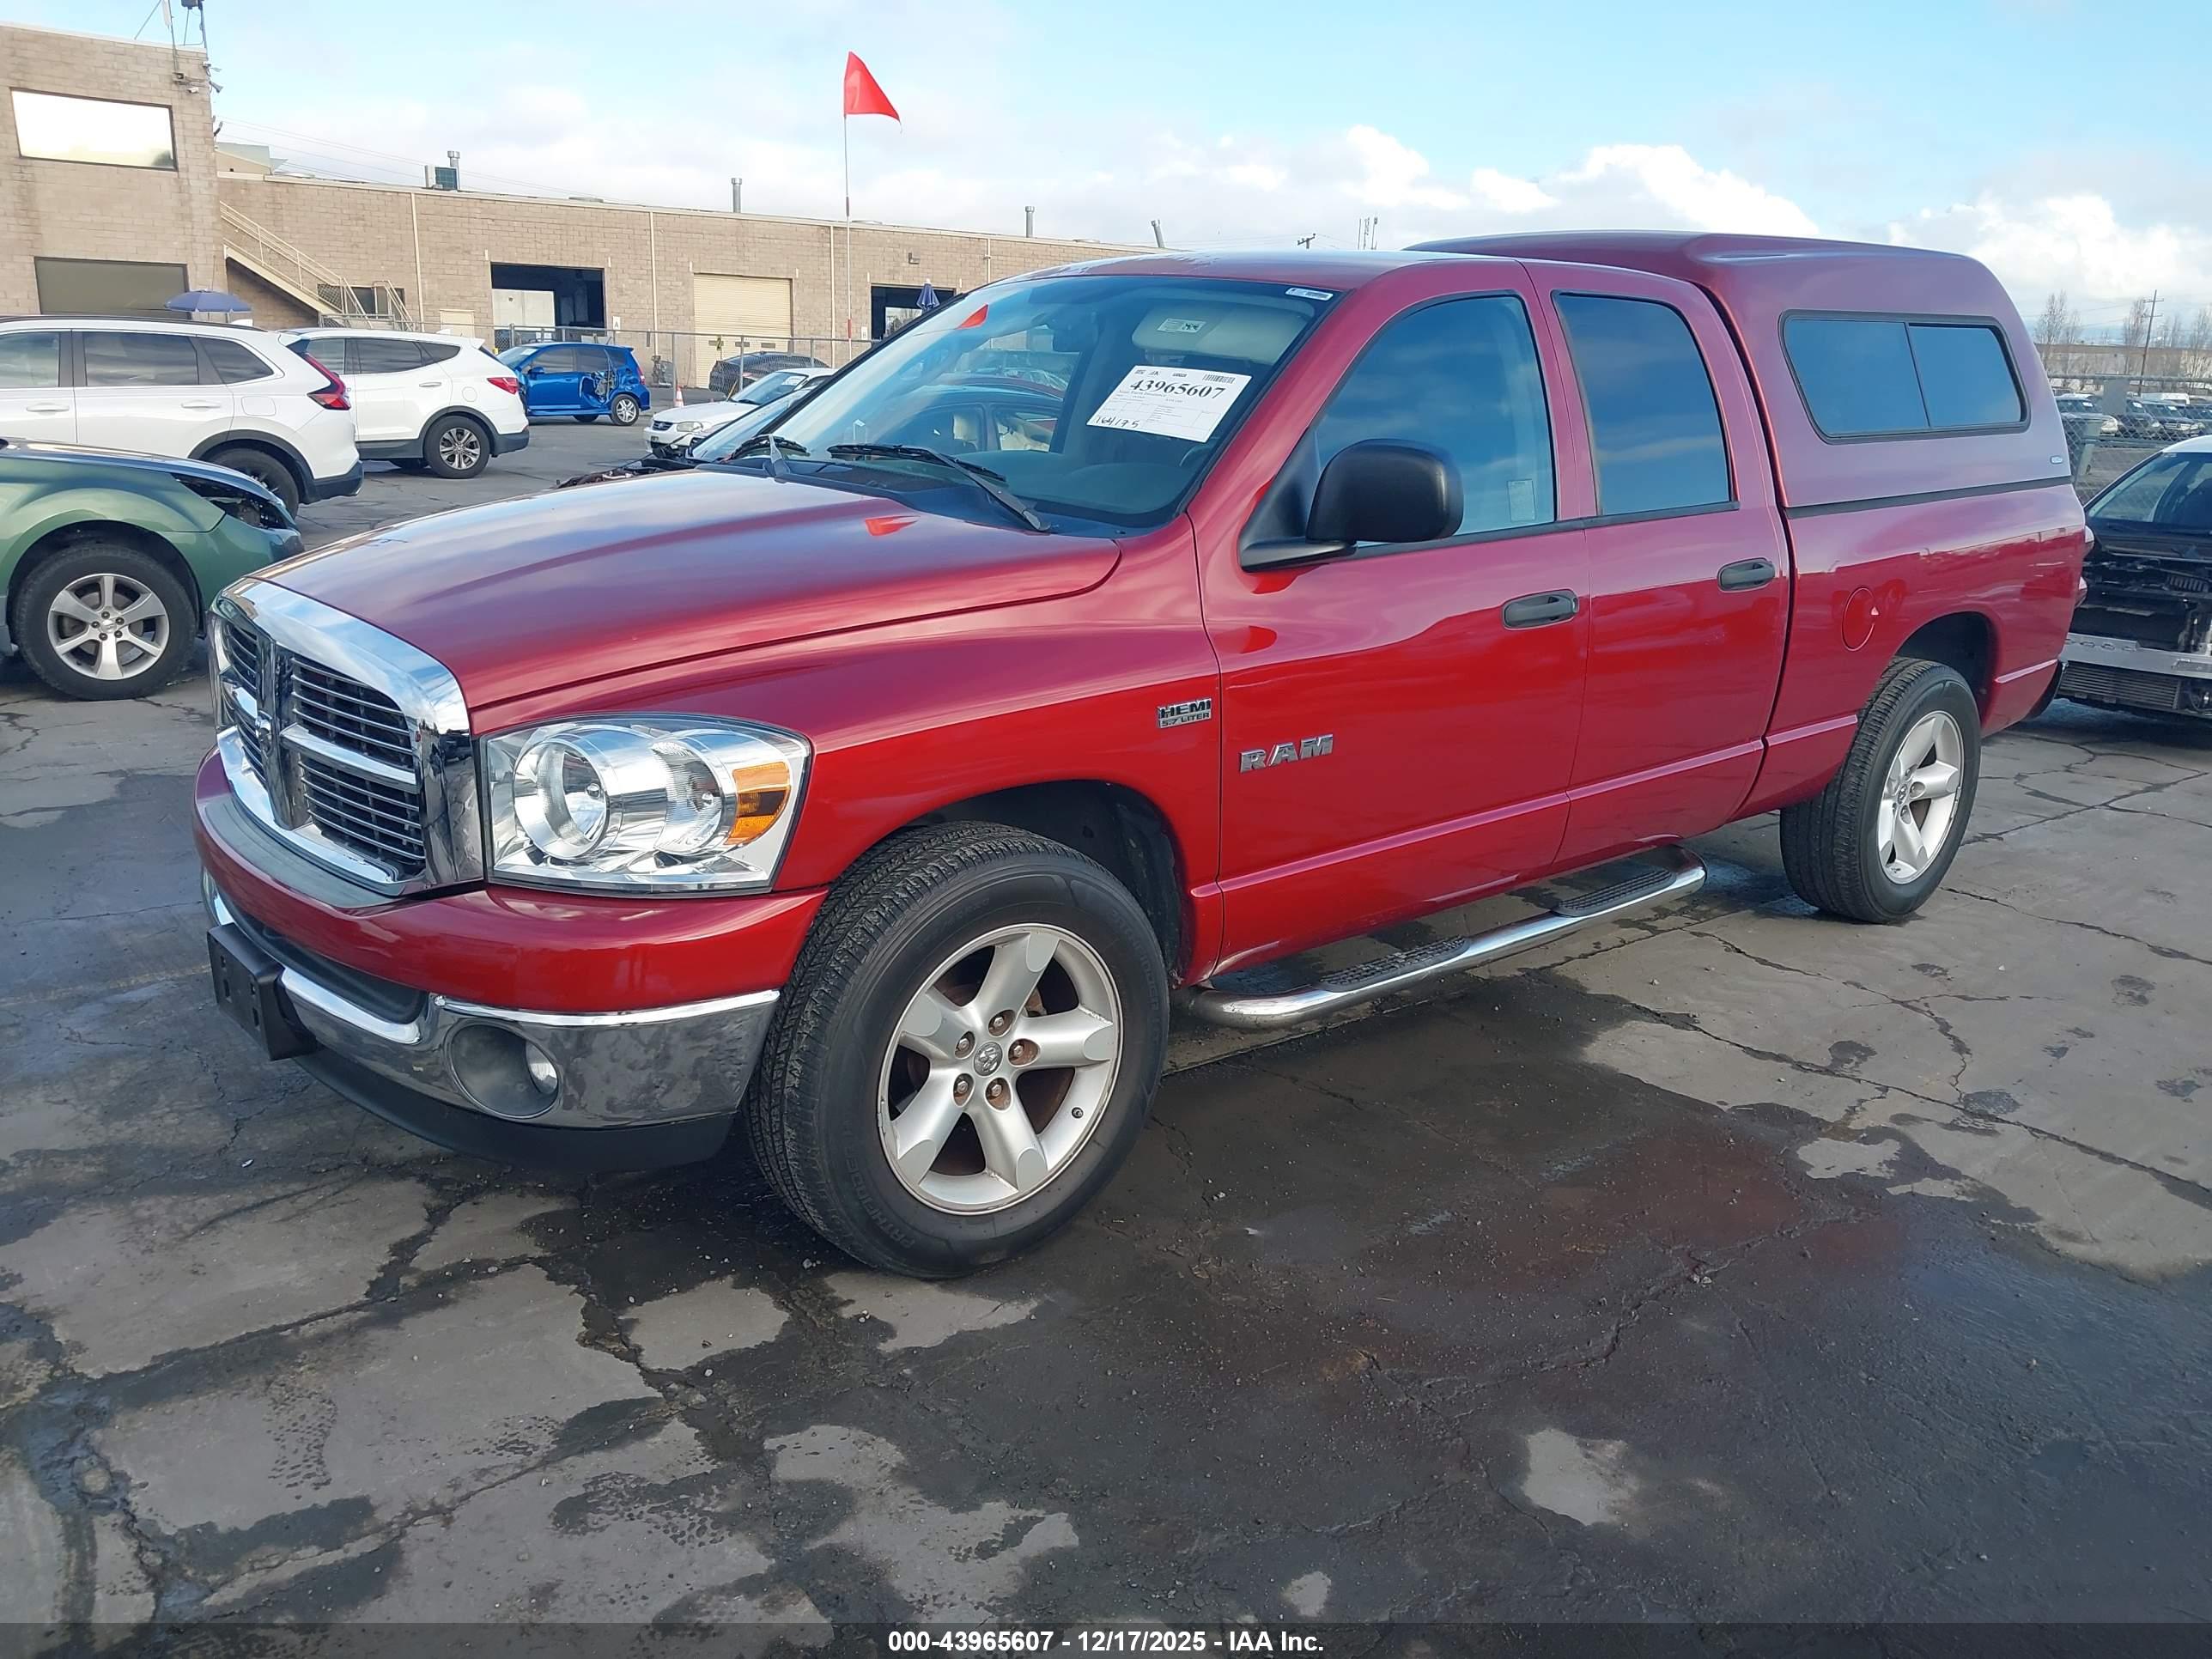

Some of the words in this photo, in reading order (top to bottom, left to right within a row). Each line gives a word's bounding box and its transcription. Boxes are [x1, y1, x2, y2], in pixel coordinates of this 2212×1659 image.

[1130, 380, 1225, 398] 43965607
[1159, 699, 1212, 719] HEMI
[1161, 718, 1178, 727] 5.7
[1181, 712, 1211, 723] LITER
[1239, 734, 1334, 773] RAM
